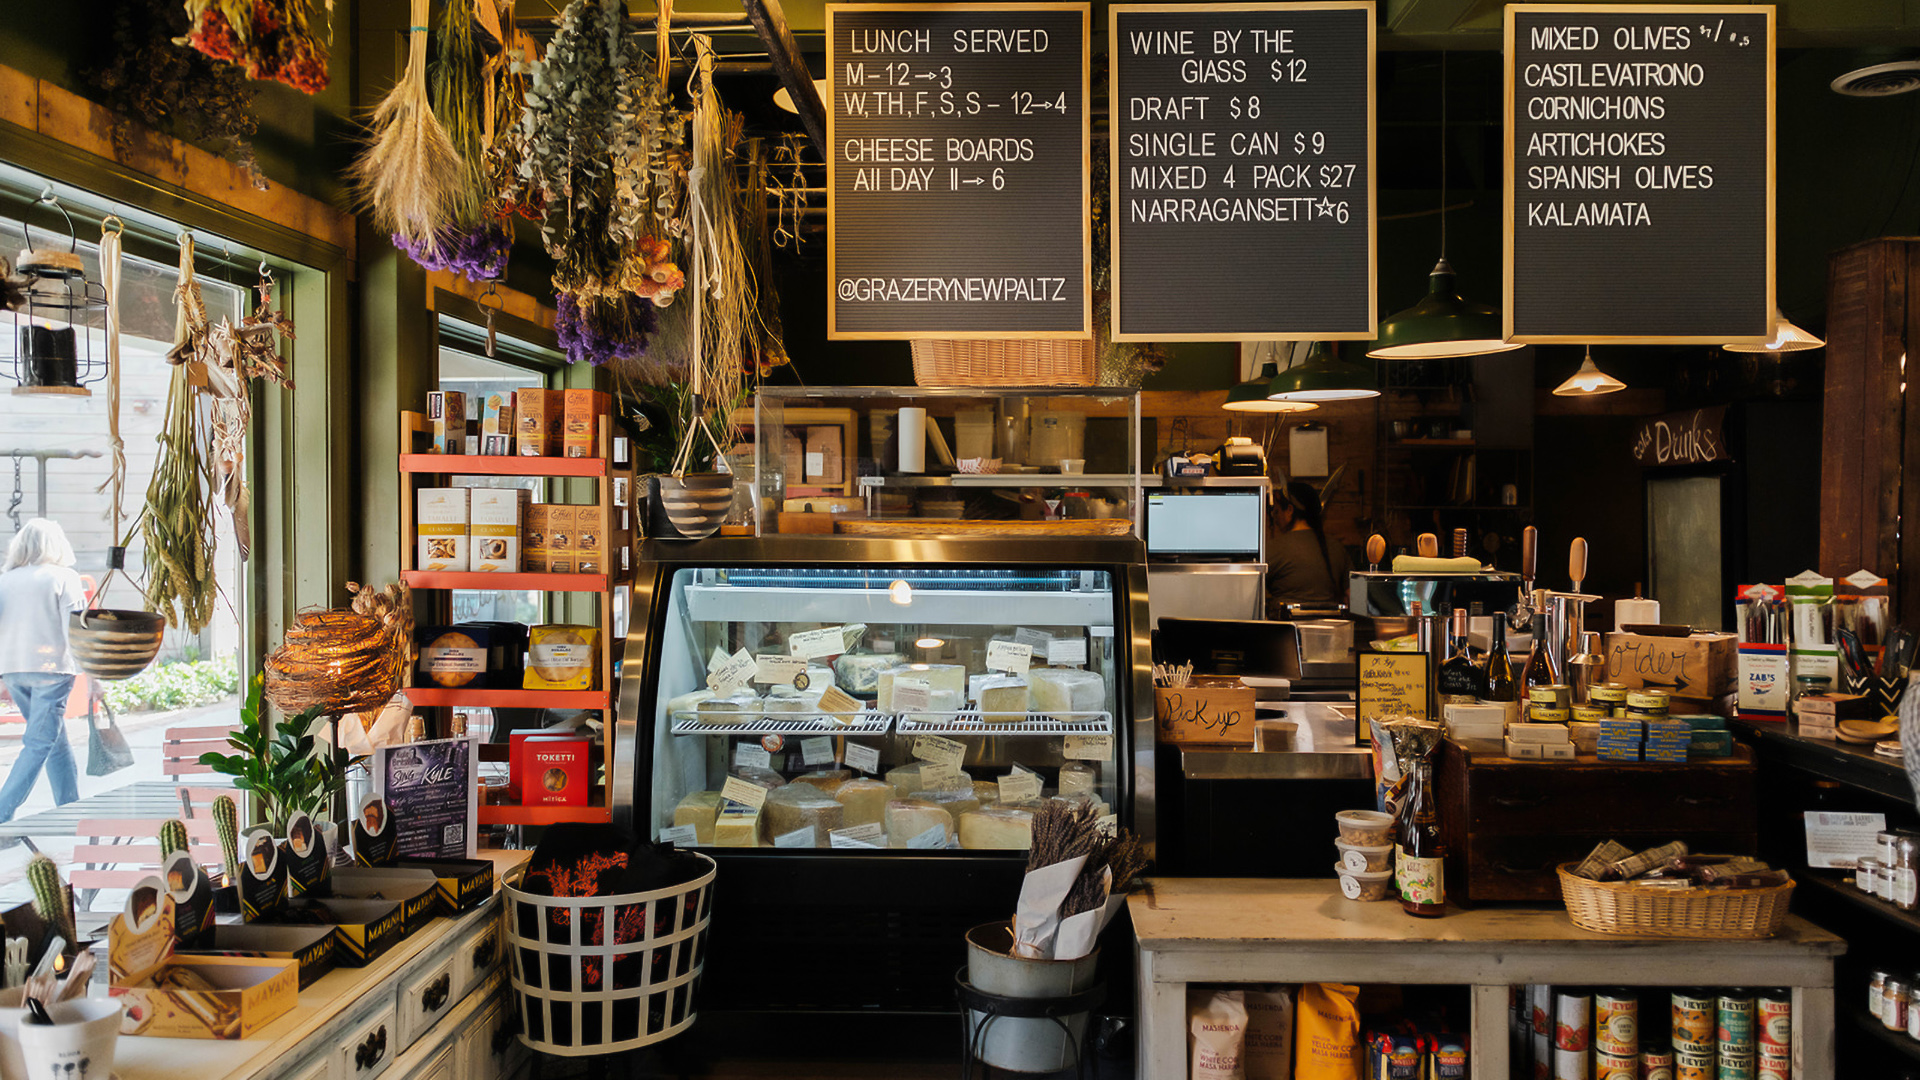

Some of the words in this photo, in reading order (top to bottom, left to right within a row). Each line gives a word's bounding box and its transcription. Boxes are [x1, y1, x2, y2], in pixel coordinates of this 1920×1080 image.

[851, 29, 930, 53] LUNCH
[953, 29, 1049, 53] SERVED
[1130, 31, 1195, 55] WINE
[1213, 29, 1242, 54] BY
[1250, 29, 1294, 54] THE
[1531, 26, 1599, 51] MIXED
[1614, 26, 1691, 51] OLIVES
[1271, 58, 1307, 83] $12
[1524, 62, 1705, 87] CASTLEVATRONO
[1130, 96, 1210, 121] DRAFT
[844, 138, 934, 162] CHEESE
[946, 138, 1034, 162] BOARDS
[1129, 132, 1216, 157] SINGLE
[1230, 131, 1279, 156] CAN
[1526, 132, 1666, 157] ARTICHOKES
[891, 167, 935, 191] DAY
[1130, 165, 1207, 190] MIXED
[1222, 164, 1236, 189] 4
[1253, 164, 1312, 189] PACK
[1319, 164, 1357, 188] $27
[1527, 165, 1620, 190] SPANISH
[1635, 165, 1714, 189] OLIVES
[1131, 197, 1317, 223] NARRAGANSETT
[1528, 202, 1651, 226] KALAMATA
[838, 277, 1067, 302] @GRAZERYNEWPALTZ
[1655, 409, 1717, 464] Drinks
[1609, 641, 1692, 681] order
[1749, 673, 1776, 682] ZAB'S
[247, 971, 296, 1011] MAYANA
[1202, 1024, 1240, 1032] MASIENDA
[1200, 1053, 1219, 1063] WHITE
[1312, 1040, 1339, 1052] YELLOW
[1312, 1047, 1328, 1057] MASA
[1200, 1062, 1217, 1070] MASA
